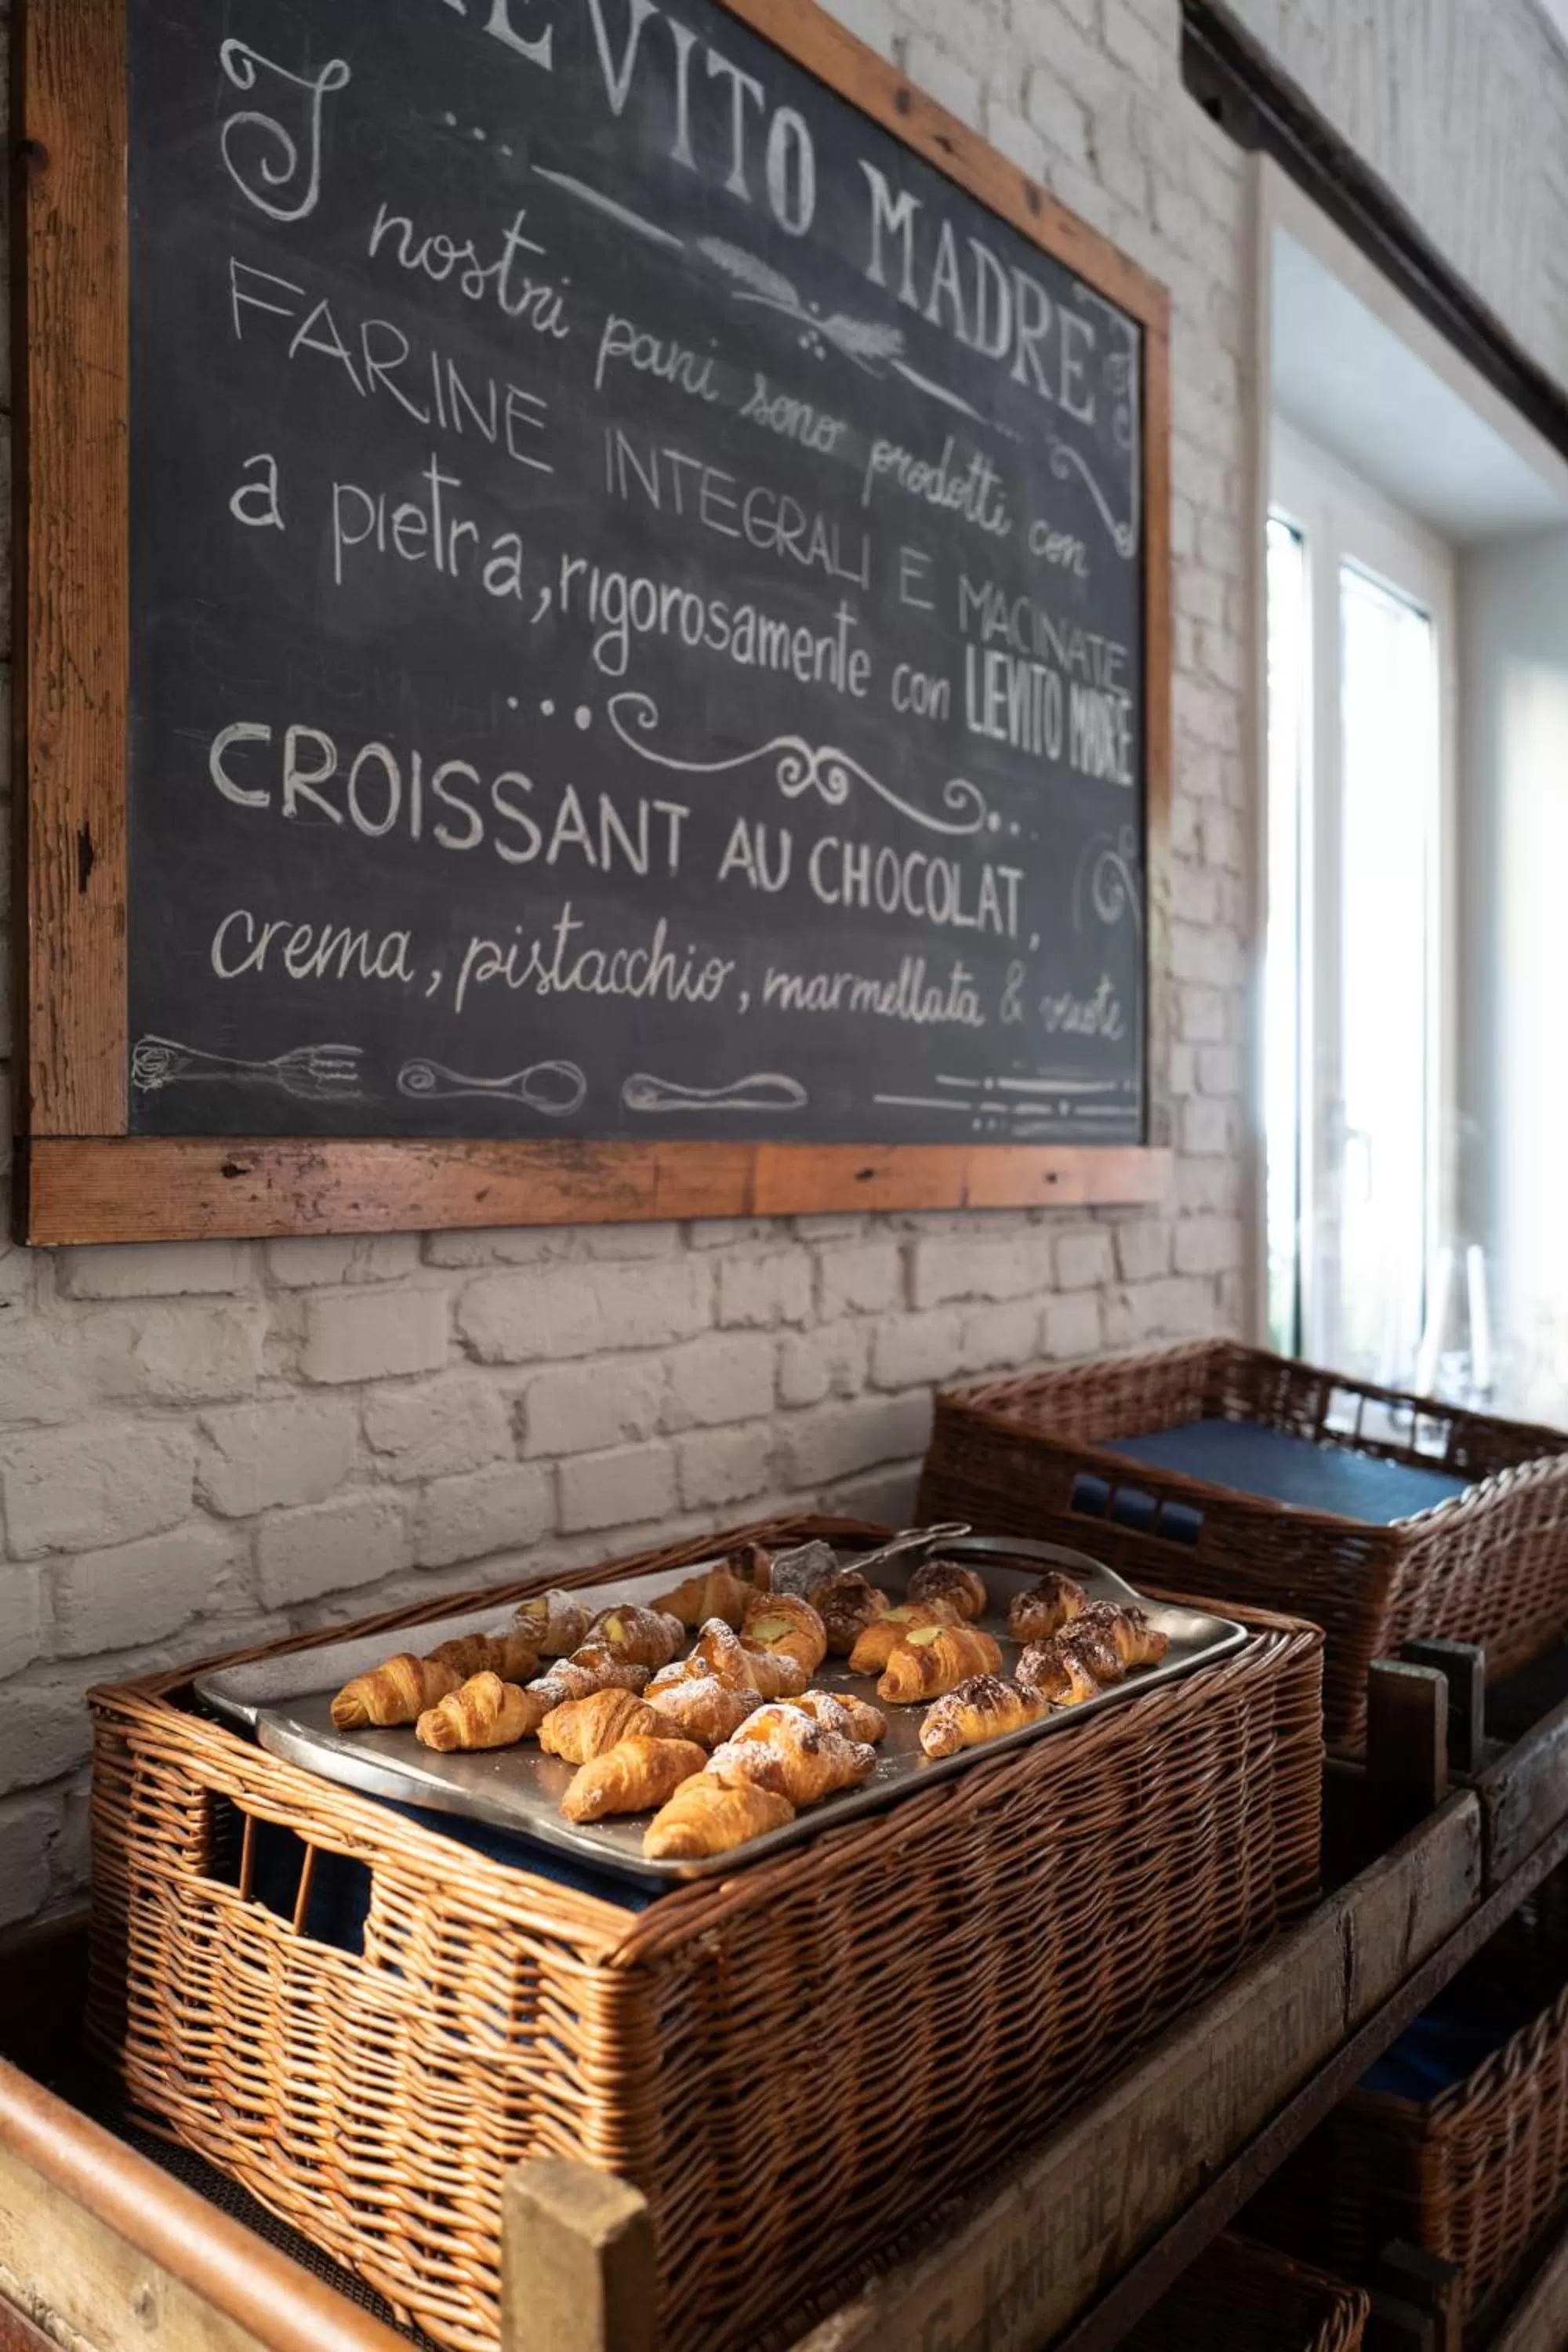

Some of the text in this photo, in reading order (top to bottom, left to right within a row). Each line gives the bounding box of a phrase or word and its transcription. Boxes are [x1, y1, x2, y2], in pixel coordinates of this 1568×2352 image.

[368, 201, 571, 339] nostri
[593, 313, 720, 401] pani
[739, 371, 847, 453] sono
[861, 434, 1014, 539] prodotti
[1028, 518, 1091, 578] con
[858, 159, 1096, 424] MADRE
[230, 256, 1132, 701] FARINE INTEGRALI E MACINATE
[230, 453, 285, 532] a
[559, 551, 872, 698] rigorosamente
[890, 662, 951, 722] con
[209, 720, 691, 876] CROISSANT
[717, 817, 793, 892] AU
[760, 954, 986, 1028] marmellata
[999, 958, 1028, 1024] &
